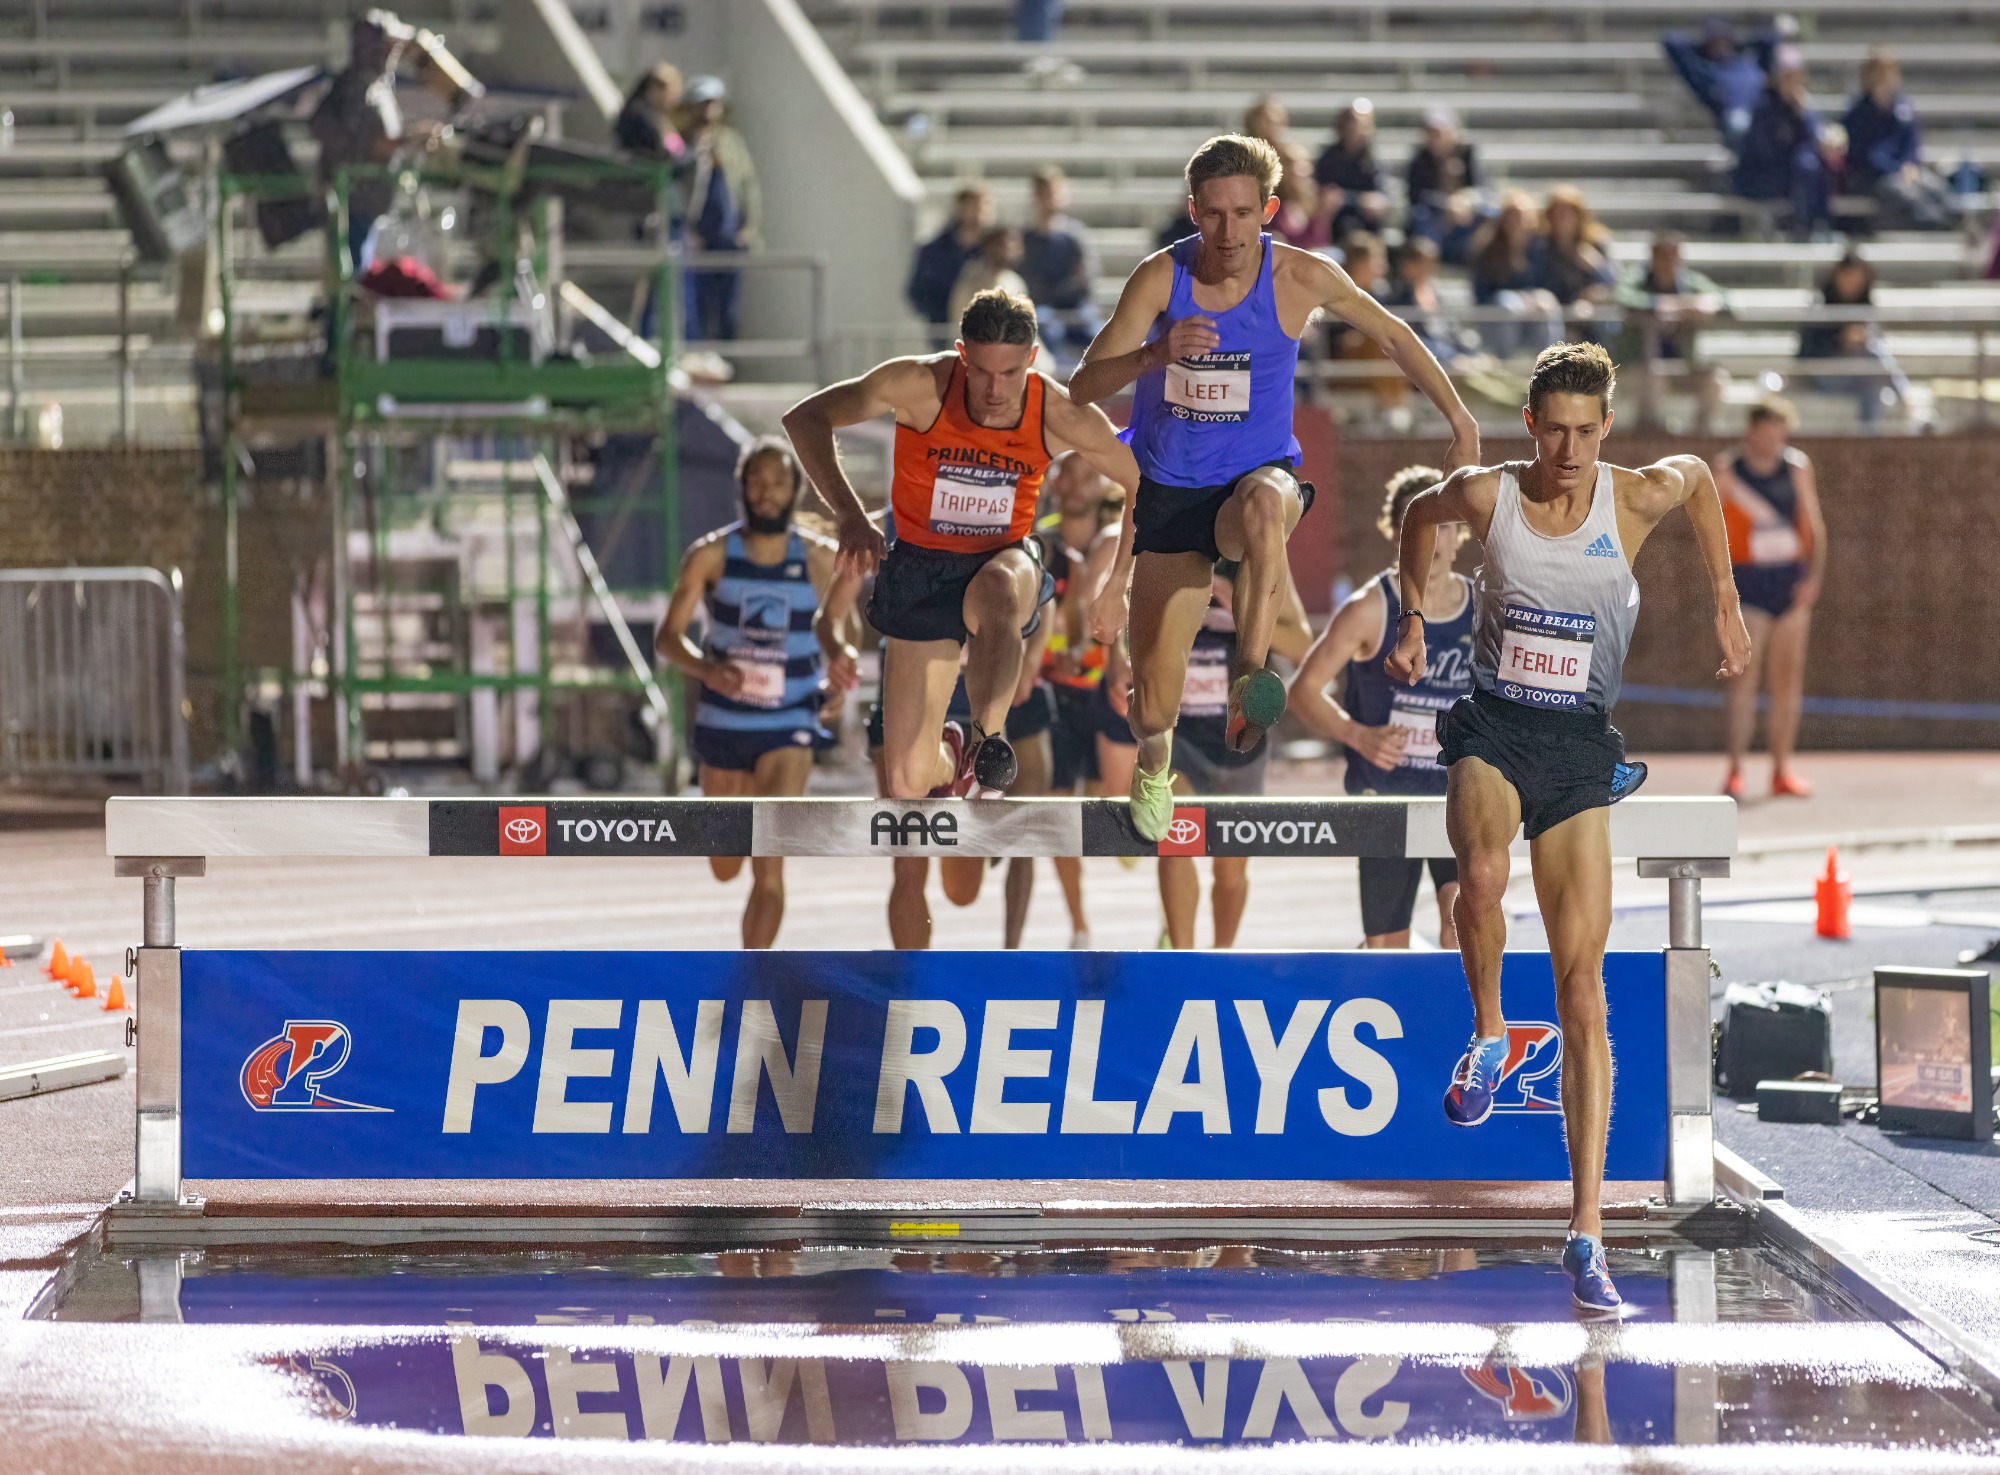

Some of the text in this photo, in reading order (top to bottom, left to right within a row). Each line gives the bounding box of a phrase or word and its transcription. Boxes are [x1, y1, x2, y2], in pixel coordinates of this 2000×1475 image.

[1202, 353, 1251, 362] RELAYS
[1185, 379, 1230, 400] LEET
[1191, 412, 1241, 422] TOYOTA
[938, 465, 973, 477] PENN
[940, 490, 1009, 515] TRIPPAS
[956, 525, 1003, 537] TOYOTA
[1584, 546, 1618, 558] adidas
[1506, 608, 1595, 630] PENN RELAYS
[1512, 645, 1578, 677] FERLIC
[1525, 688, 1577, 705] TOYOTA
[557, 819, 677, 842] TOYOTA
[1216, 820, 1338, 844] TOYOTA
[442, 997, 1404, 1137] PENN RELAYS
